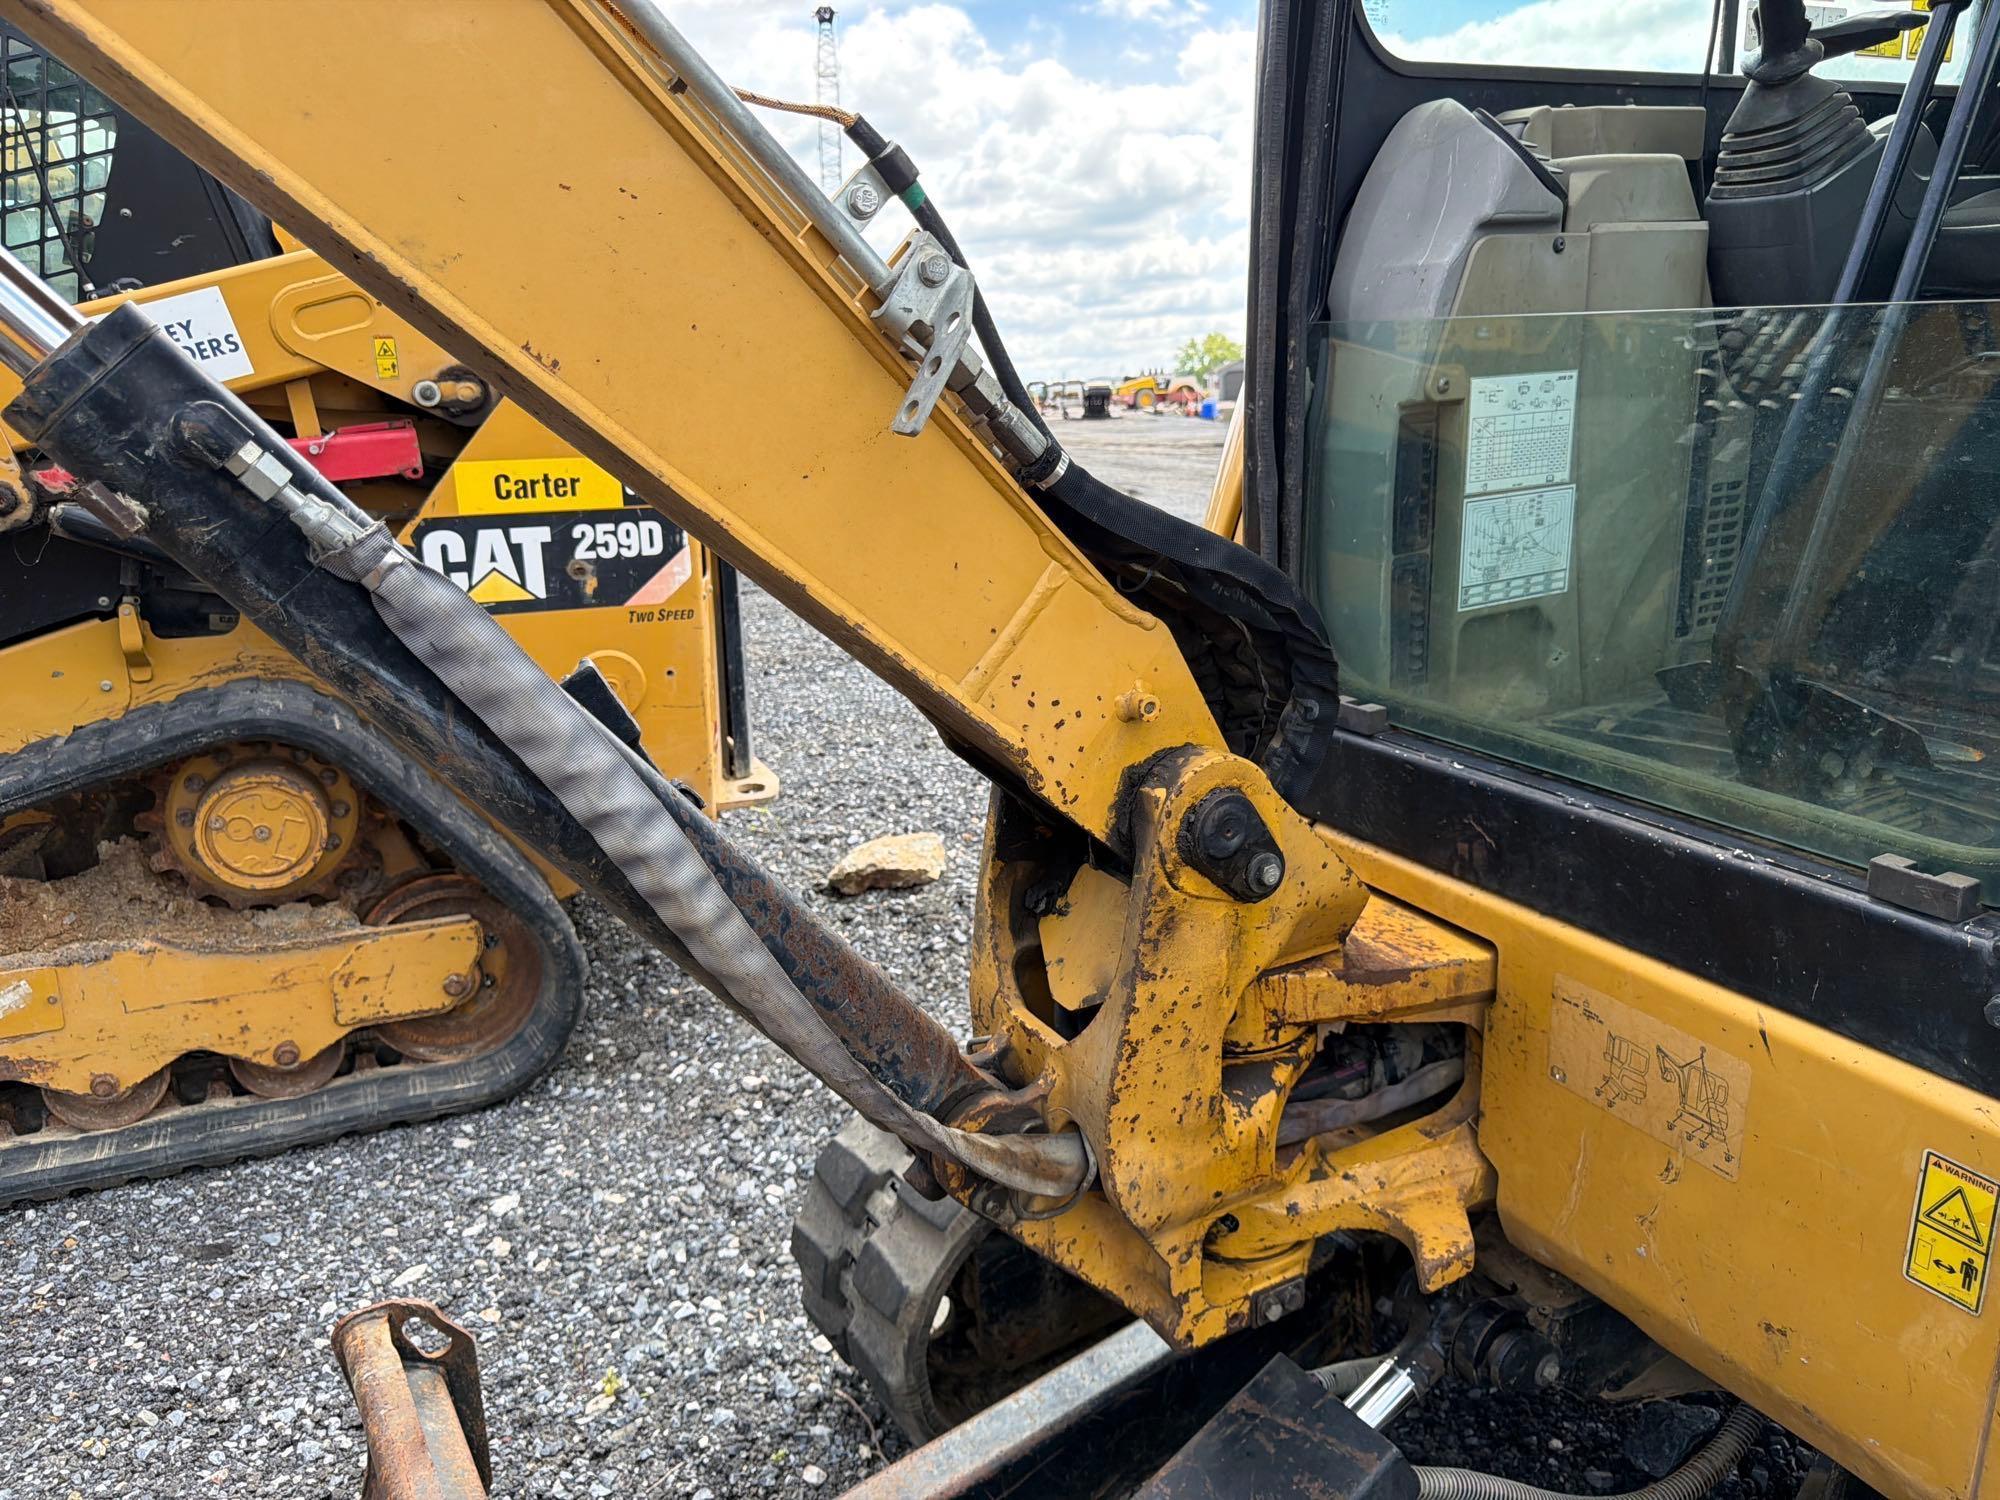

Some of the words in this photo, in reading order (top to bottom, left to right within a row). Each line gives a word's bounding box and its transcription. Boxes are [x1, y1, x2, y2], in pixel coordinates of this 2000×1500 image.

[164, 319, 193, 342] EY
[181, 333, 240, 360] DERS
[494, 474, 581, 500] Carter
[421, 525, 552, 600] CAT
[572, 520, 664, 560] 259D
[1944, 1164, 1995, 1195] WARNING
